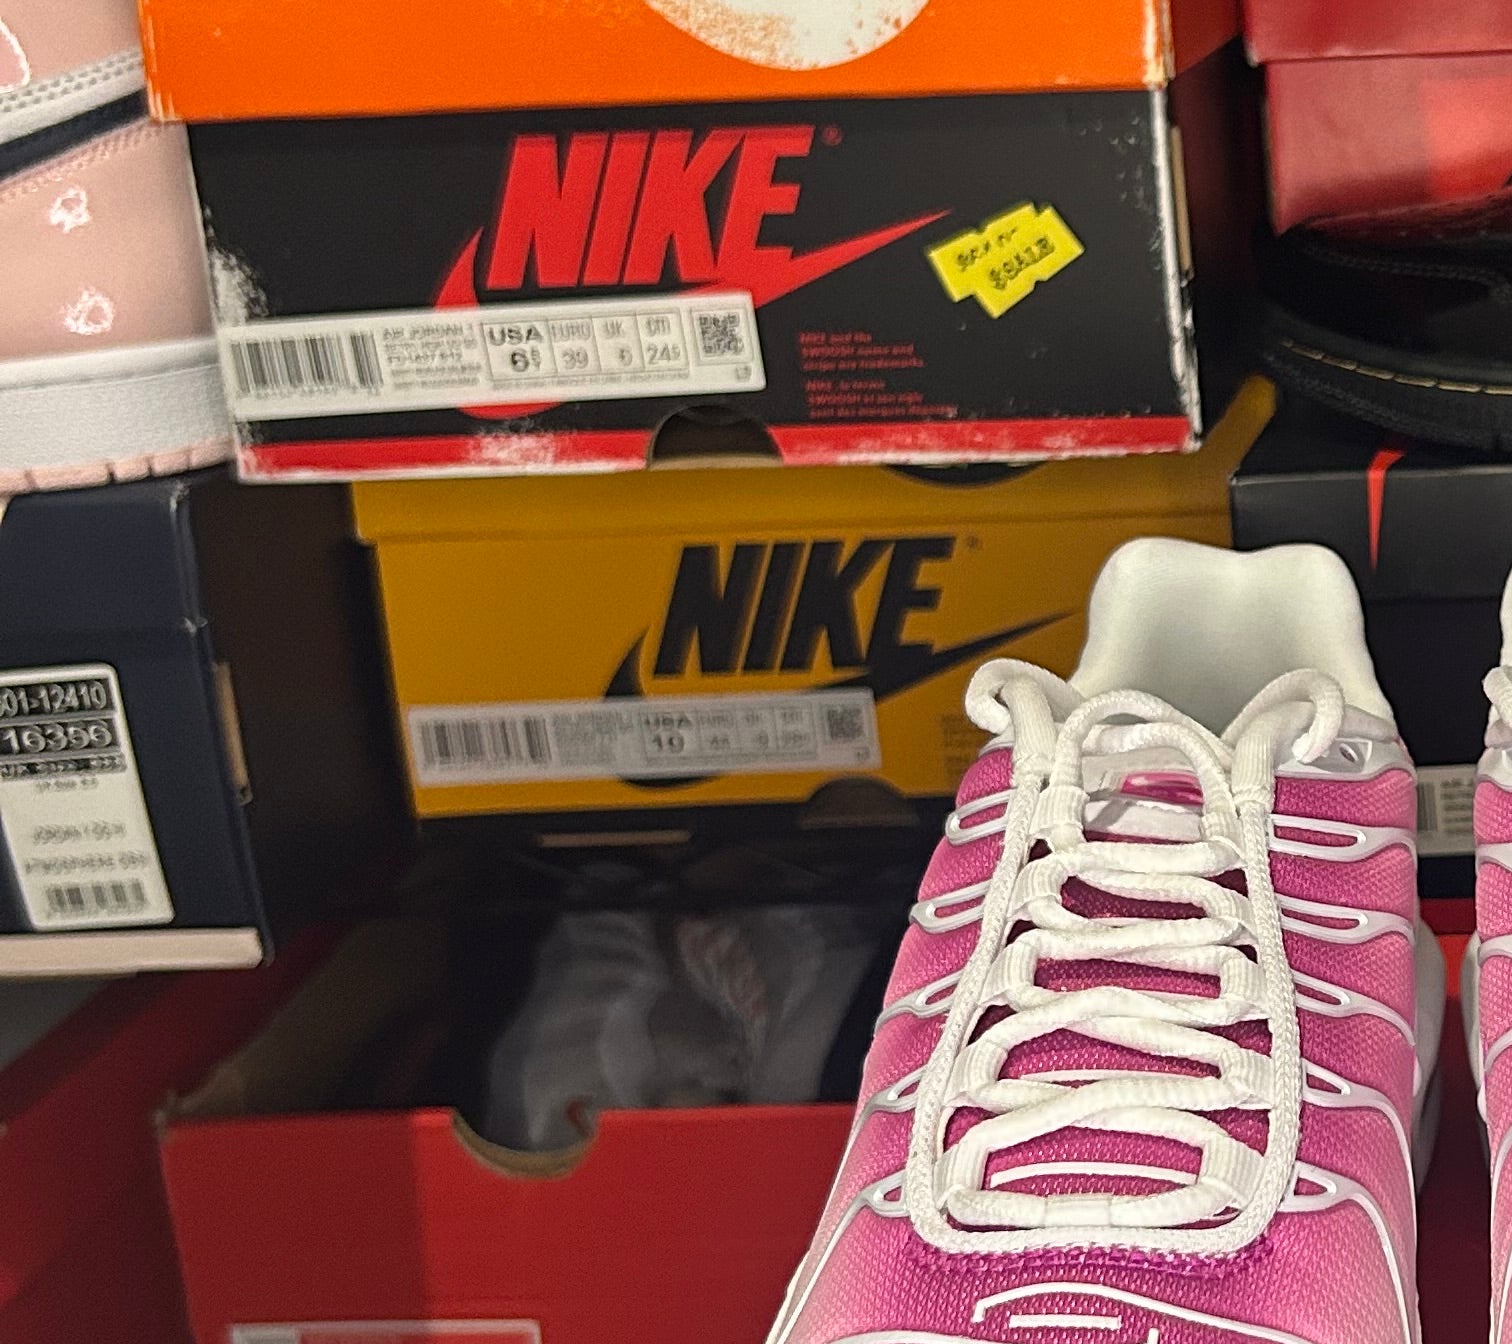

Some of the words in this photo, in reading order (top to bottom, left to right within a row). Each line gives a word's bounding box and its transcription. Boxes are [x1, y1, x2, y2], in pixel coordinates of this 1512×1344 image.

[486, 124, 815, 289] NIKE
[487, 325, 544, 347] USA
[653, 536, 956, 679] NIKE
